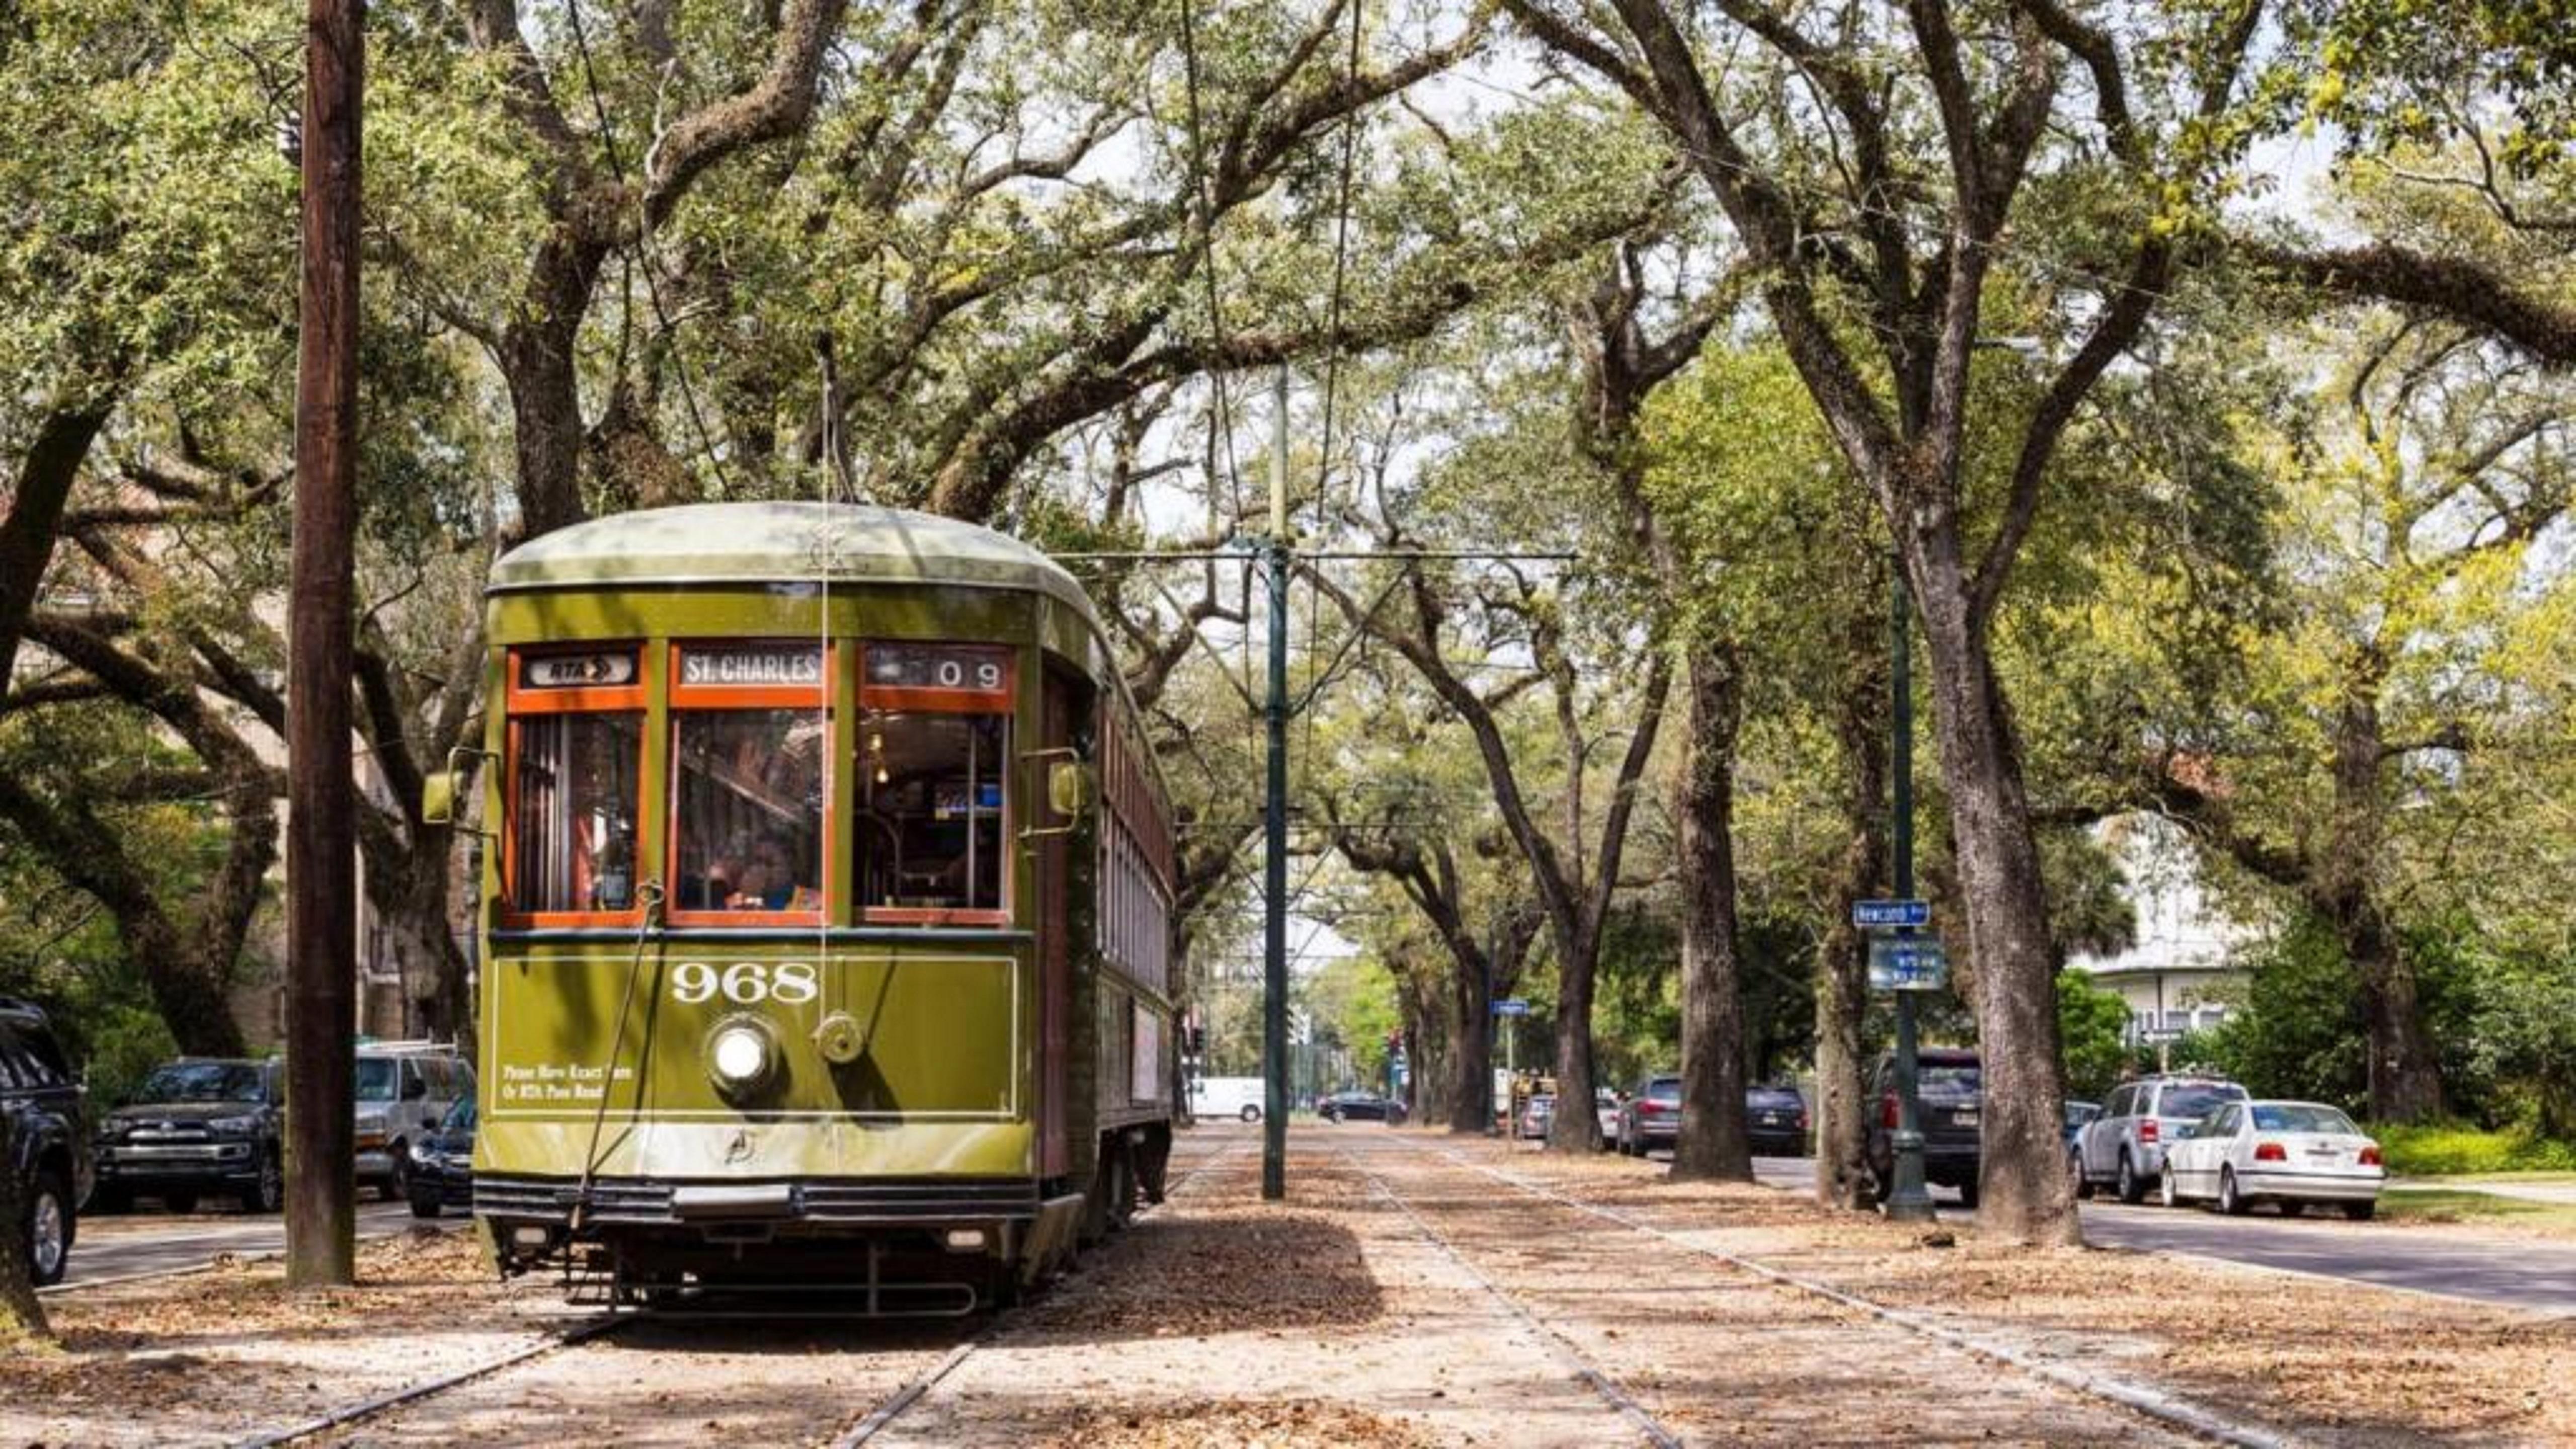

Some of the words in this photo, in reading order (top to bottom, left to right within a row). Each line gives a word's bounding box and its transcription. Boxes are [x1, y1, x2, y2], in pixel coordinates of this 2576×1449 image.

[687, 656, 715, 682] ST.
[721, 656, 816, 682] CHARLES
[672, 962, 818, 1004] 968
